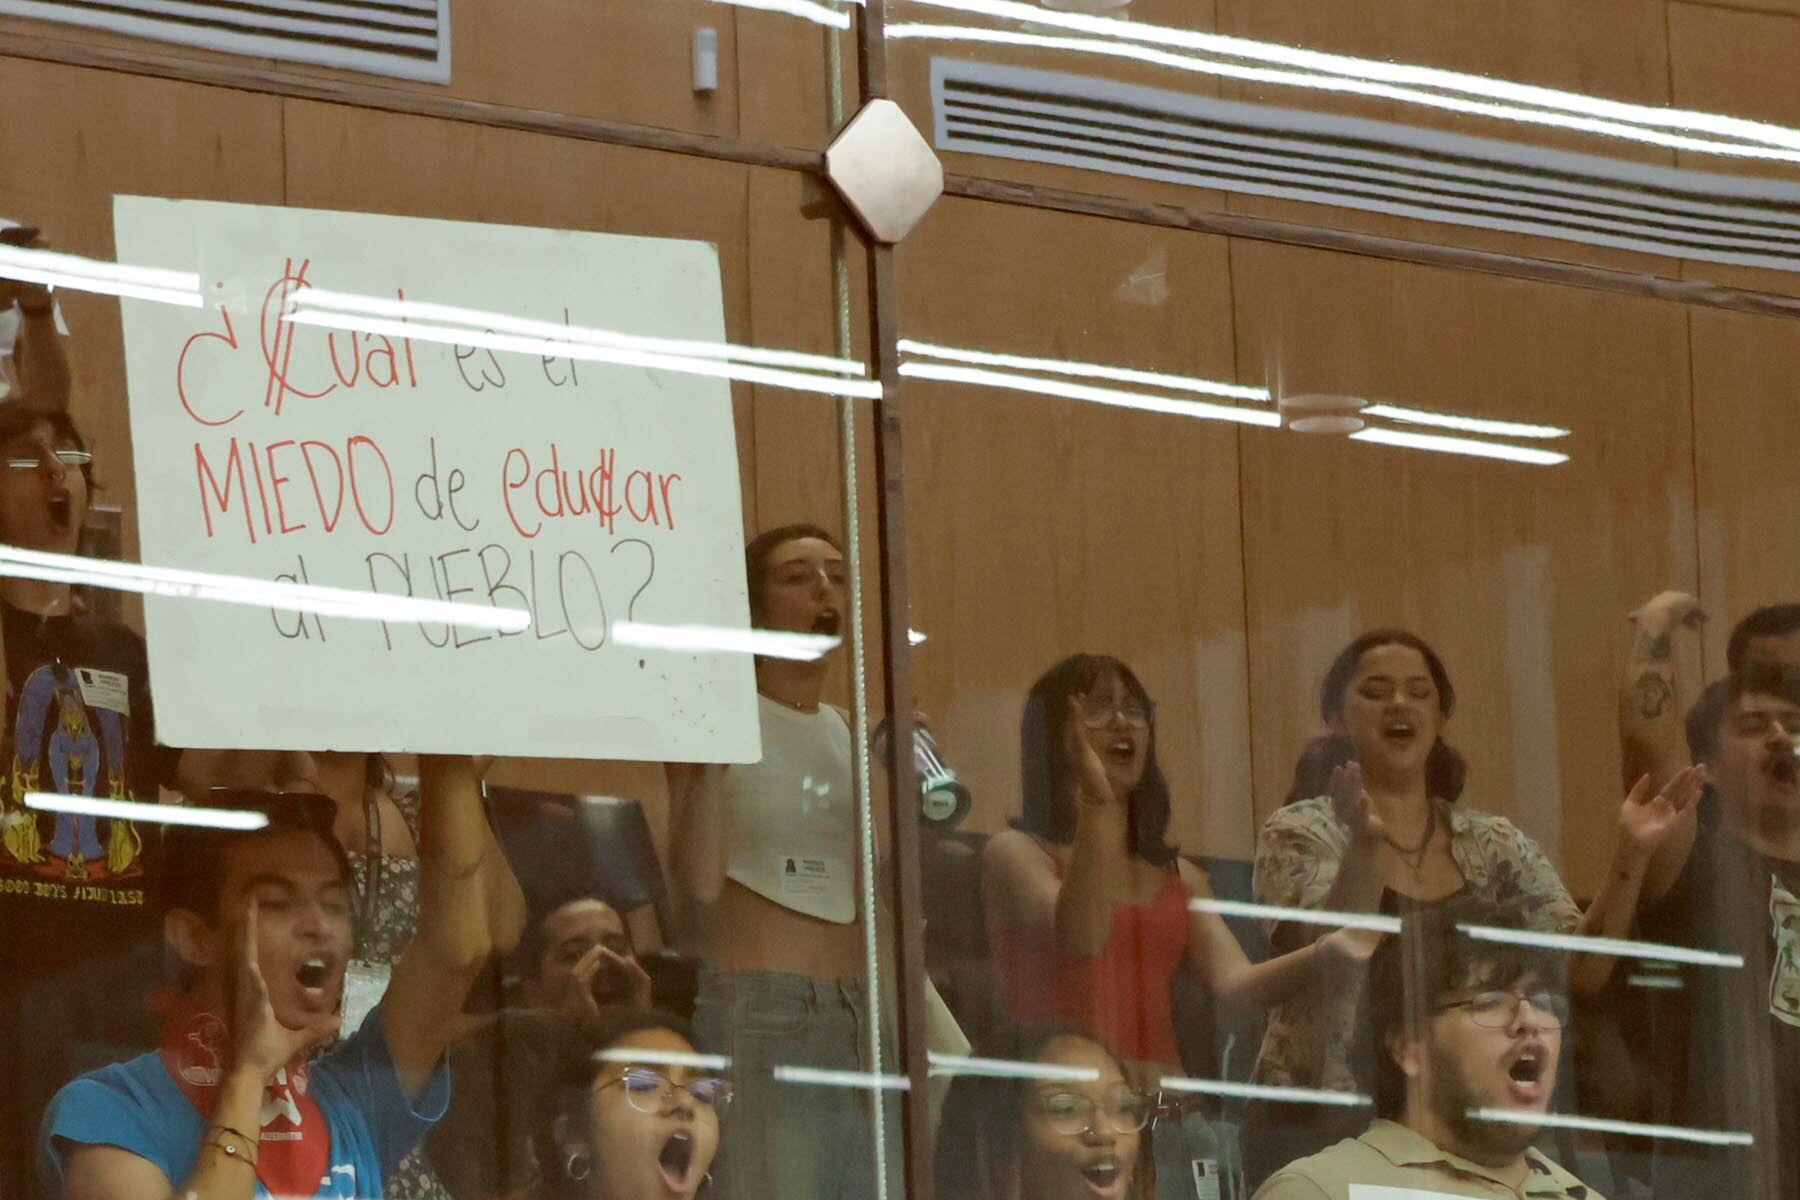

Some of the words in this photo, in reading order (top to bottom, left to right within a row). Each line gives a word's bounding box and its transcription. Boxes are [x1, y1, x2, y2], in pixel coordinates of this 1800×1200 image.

[454, 328, 506, 392] es
[542, 307, 578, 387] el
[195, 435, 394, 543] MIEDO
[415, 437, 479, 531] de
[271, 554, 326, 642] al
